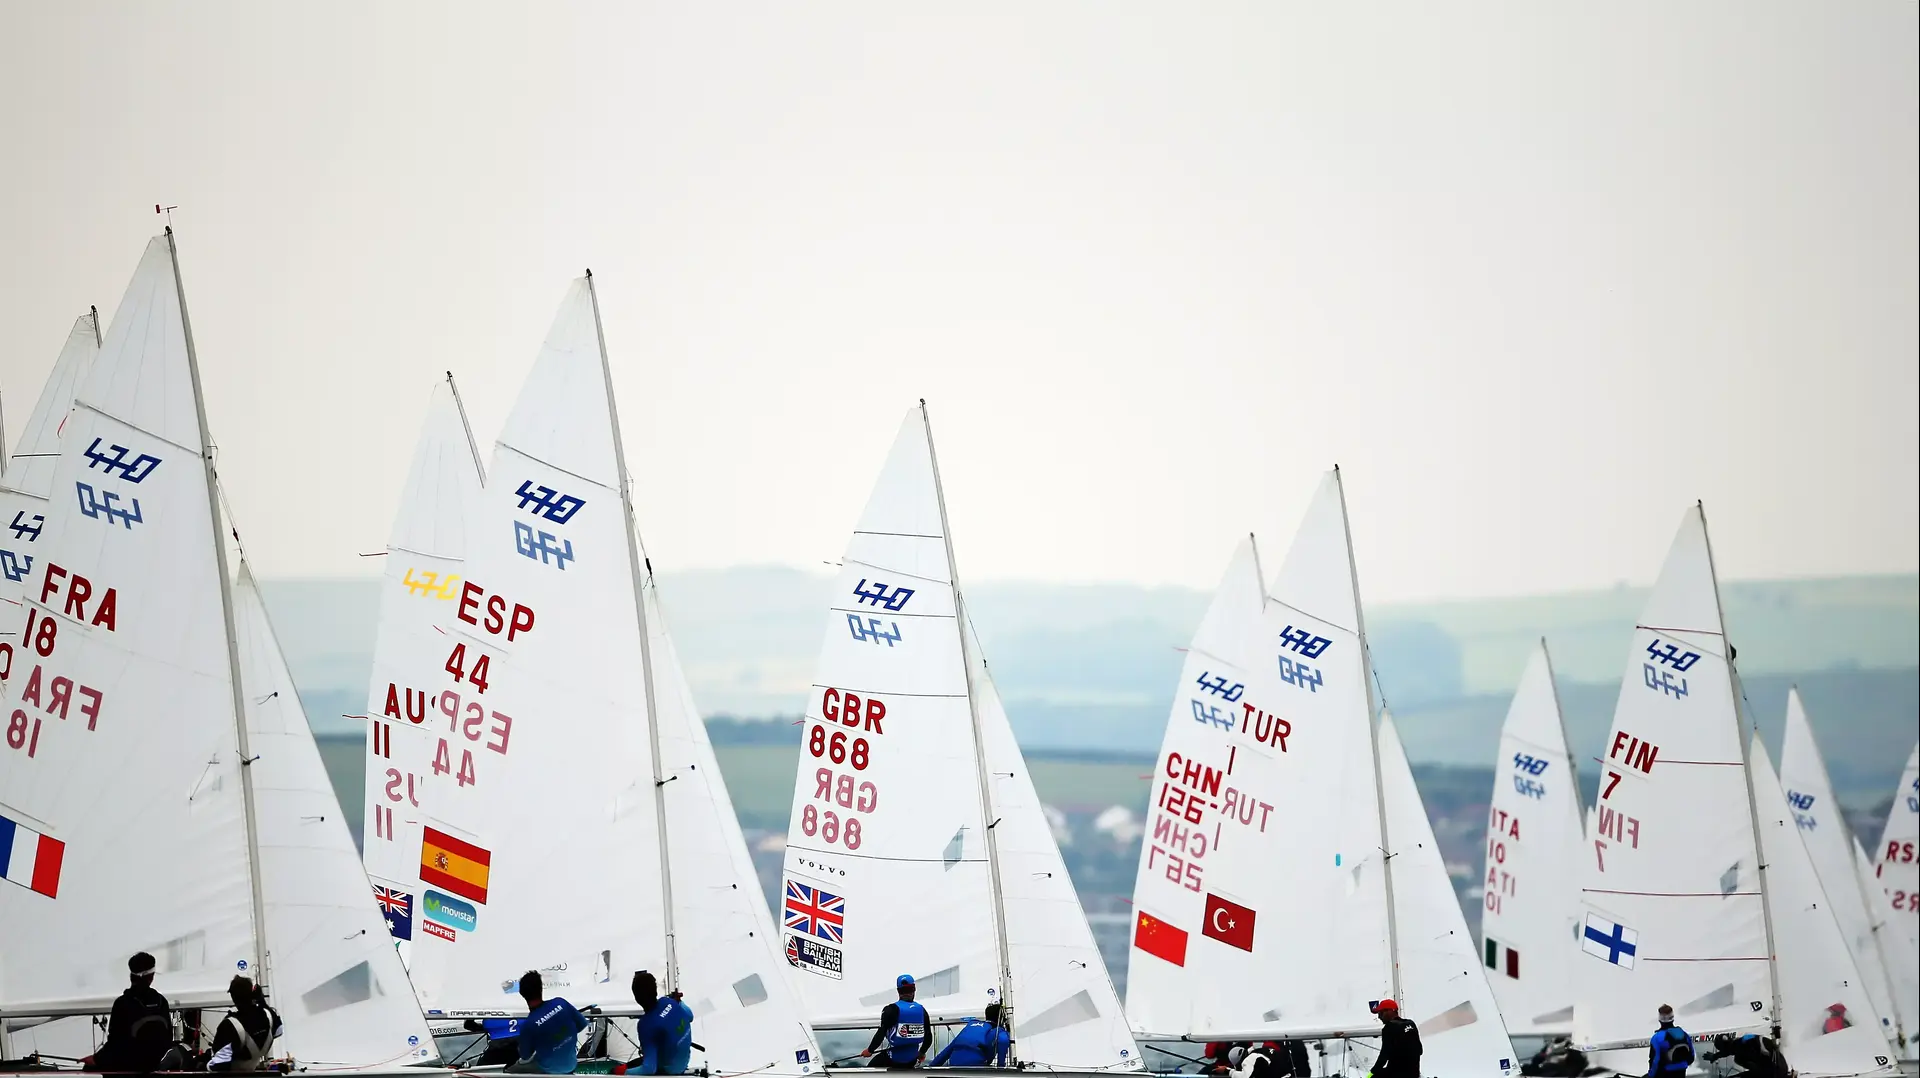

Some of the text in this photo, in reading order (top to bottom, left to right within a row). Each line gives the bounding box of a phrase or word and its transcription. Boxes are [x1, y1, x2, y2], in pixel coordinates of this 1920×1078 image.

[84, 437, 163, 484] 470
[515, 480, 587, 525] 470
[9, 510, 45, 542] 47
[41, 562, 117, 632] FRA
[457, 581, 535, 642] ESP
[853, 579, 915, 611] 470
[23, 608, 58, 657] 18
[1279, 625, 1333, 659] 470
[445, 643, 490, 694] 44
[1646, 639, 1701, 672] 470
[384, 683, 437, 724] AU
[822, 688, 886, 735] GBR
[1242, 702, 1292, 752] TUR
[809, 725, 870, 770] 868
[1610, 730, 1659, 774] FIN
[1166, 752, 1223, 797] CHN
[1602, 771, 1622, 800] 7
[1491, 806, 1520, 841] ITA
[799, 858, 846, 877] VOLVO
[1886, 841, 1919, 866] RS
[423, 922, 455, 939] MAPFRE
[441, 905, 475, 923] movistar
[803, 947, 841, 965] SAILING
[804, 940, 841, 958] BRITISH
[813, 957, 841, 971] TEAM
[429, 1027, 458, 1035] 016.com
[508, 1019, 518, 1033] 2
[535, 1004, 563, 1027] XAMMAR
